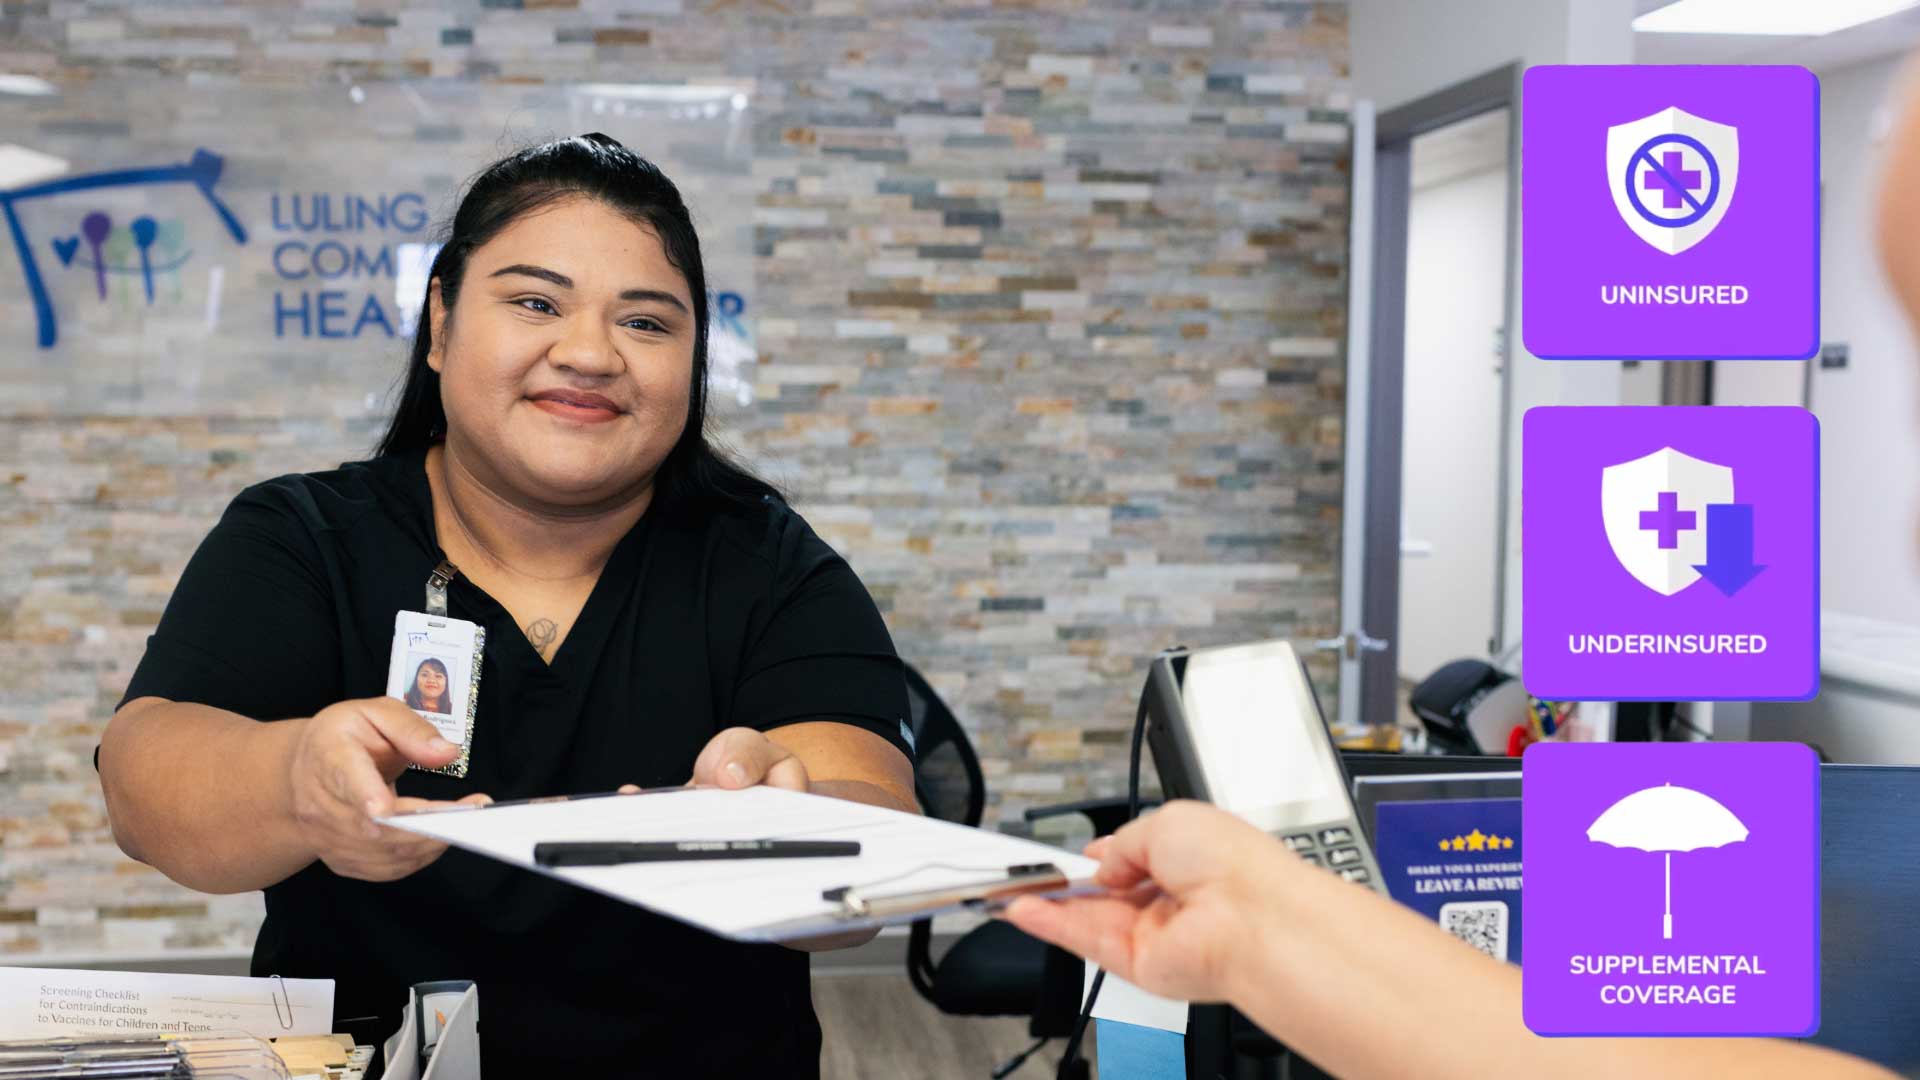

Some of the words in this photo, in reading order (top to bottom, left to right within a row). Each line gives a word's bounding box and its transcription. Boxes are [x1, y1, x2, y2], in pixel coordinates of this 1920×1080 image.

[272, 193, 429, 232] LULING
[273, 240, 397, 280] COM
[274, 291, 395, 339] HEA
[1444, 864, 1473, 874] YOUR
[1415, 877, 1463, 893] LEAVE
[1464, 878, 1475, 892] A
[40, 985, 92, 999] Screening
[95, 988, 140, 1000] Checklist
[39, 1000, 55, 1009] for
[58, 1001, 148, 1015] Contraindications
[38, 1014, 48, 1023] to
[52, 1014, 96, 1026] Vaccines
[99, 1016, 113, 1027] for
[116, 1018, 158, 1031] Children
[160, 1021, 180, 1031] and
